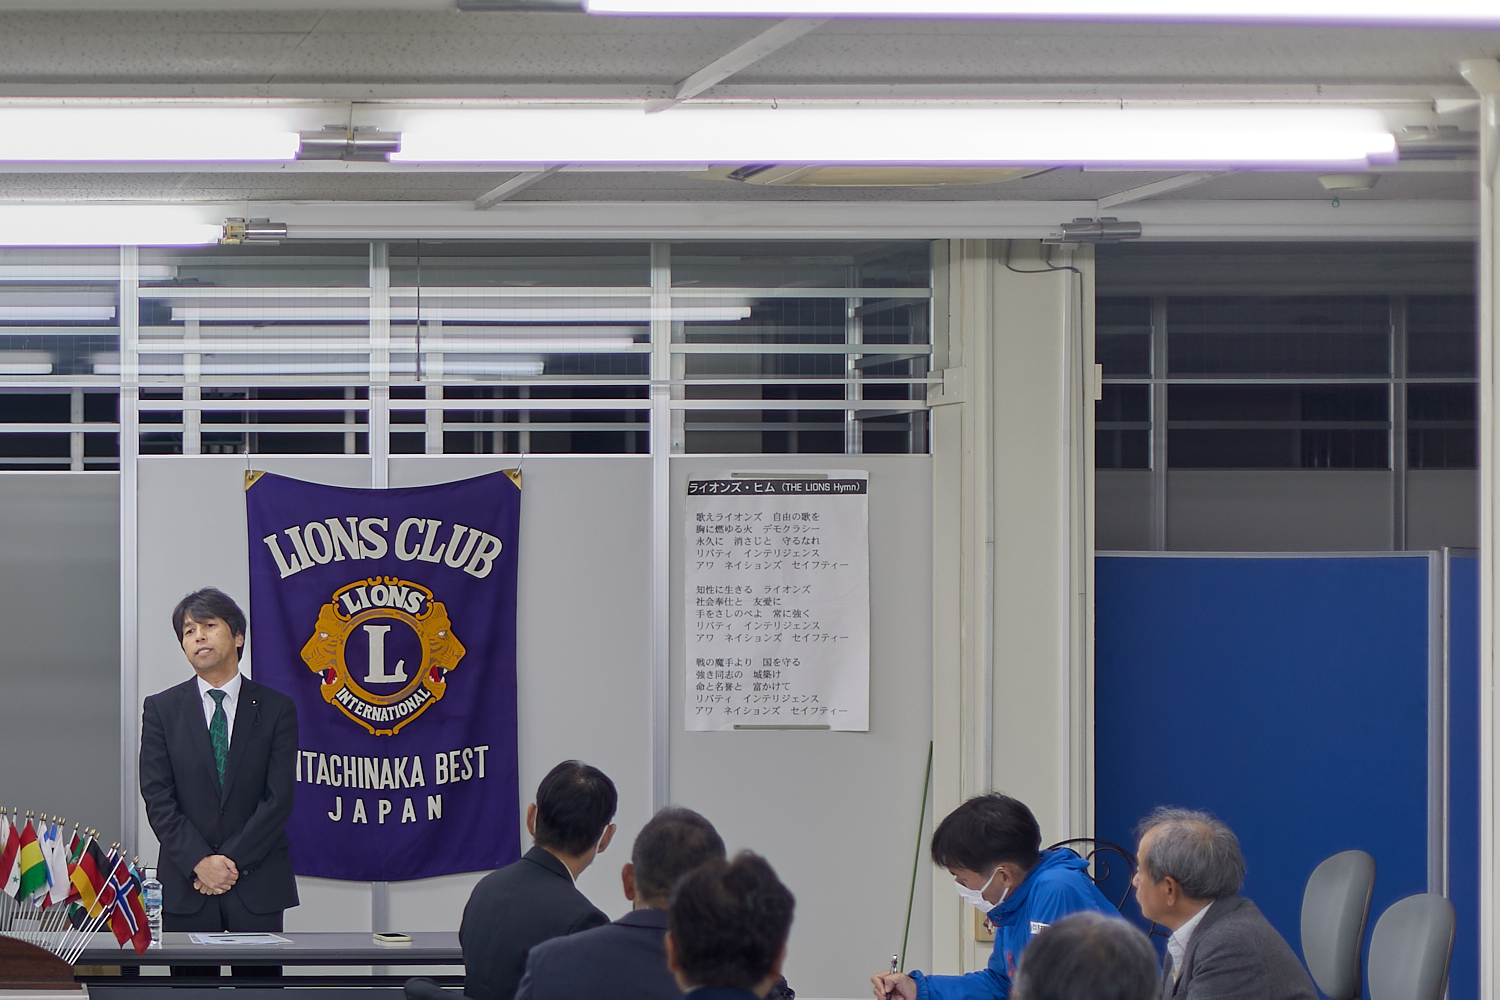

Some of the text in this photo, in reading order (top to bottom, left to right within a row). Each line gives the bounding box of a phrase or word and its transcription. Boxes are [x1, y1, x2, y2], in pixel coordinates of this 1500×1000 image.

[805, 482, 831, 492] LIONS
[696, 512, 819, 522] 歌えライオンズ 自由の歌を
[696, 524, 820, 534] 胸に燃ゆる火 デモクラシー
[696, 536, 820, 546] 永久に 消さじと 守るなれ
[263, 516, 504, 580] LIONS CLUB
[697, 549, 819, 558] リバティ インテリジェンス
[697, 560, 848, 570] アワ ネイションズ セイフティー
[696, 585, 811, 594] 知性に生きる ライオンズ
[339, 584, 426, 614] LIONS
[696, 597, 781, 606] 社会奉仕と 友愛に
[696, 609, 809, 618] 手をさしのべよ 常に強く
[697, 622, 820, 630] リバティ インテリジェンス
[697, 633, 848, 642] アワ ネイションズ セイフティー
[363, 625, 408, 683] L
[763, 657, 800, 667] 国を守る
[696, 670, 743, 679] 強き同志の
[696, 682, 790, 691] 命と名誉と 富かけて
[696, 694, 818, 703] リバティ インテリジェンス
[335, 686, 431, 723] INTERNATIONAL
[696, 706, 847, 715] アワ ネイションズ セイフティー
[296, 745, 489, 790] ITACHINAKA BEST
[328, 794, 442, 824] JAPAN
